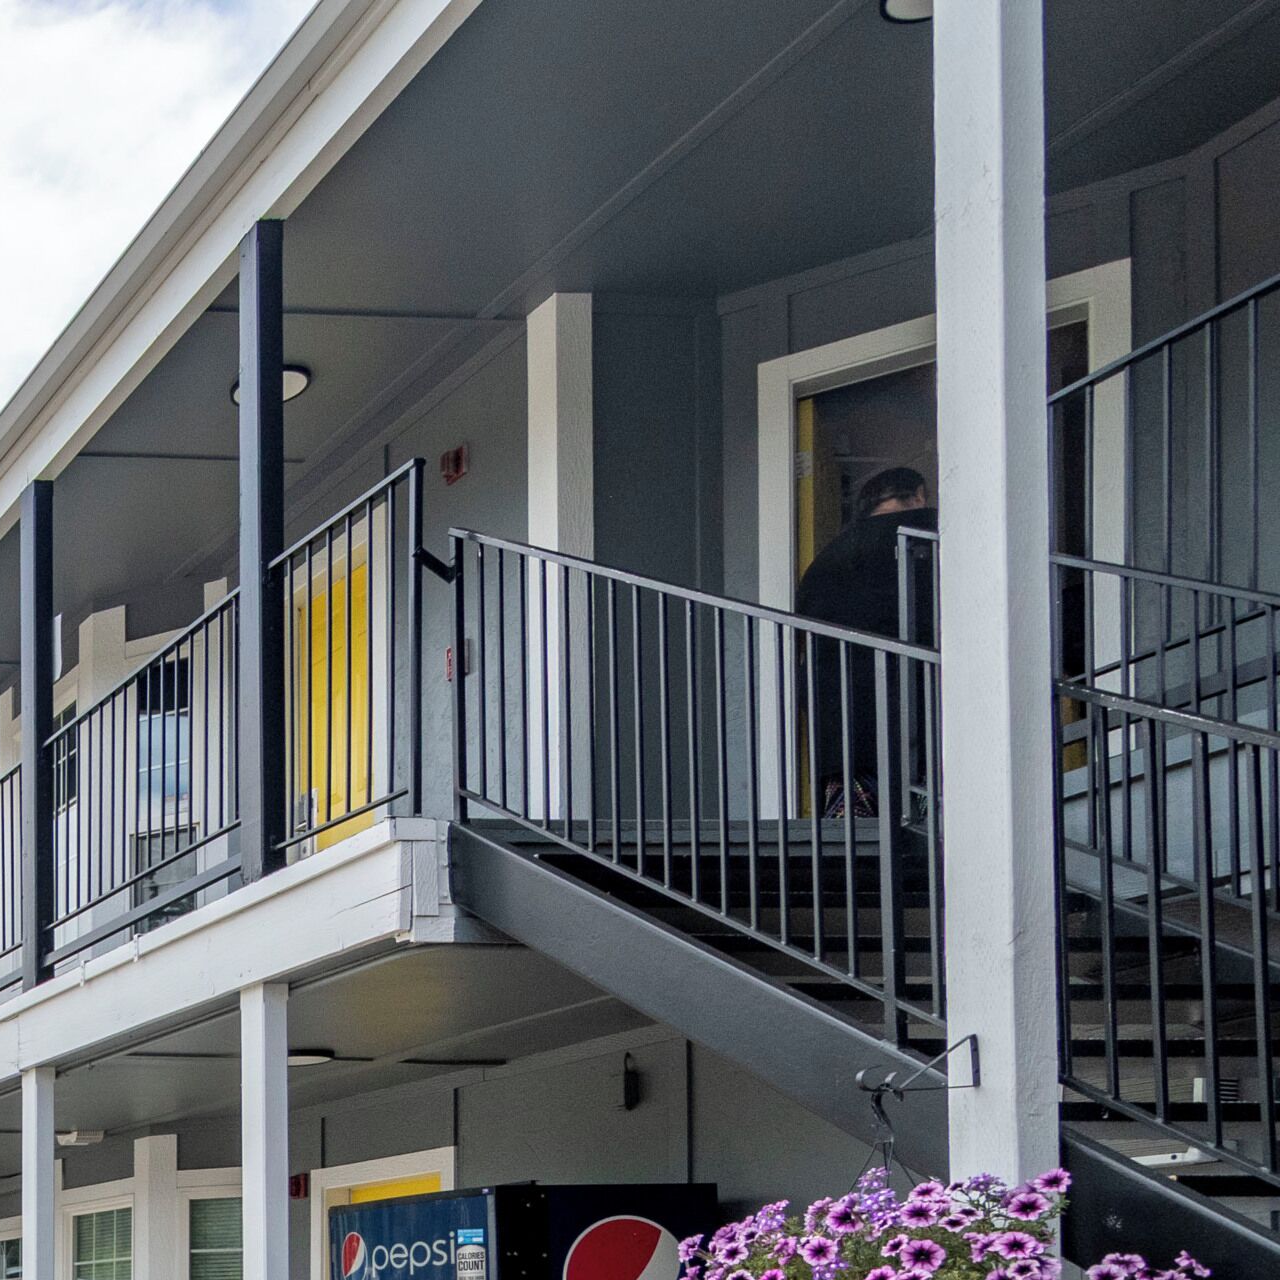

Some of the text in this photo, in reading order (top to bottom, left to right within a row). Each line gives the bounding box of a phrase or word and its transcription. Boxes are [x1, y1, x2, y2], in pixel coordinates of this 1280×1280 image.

[371, 1230, 456, 1278] pepsi
[457, 1252, 485, 1260] CALORIES
[457, 1260, 485, 1271] COUNT
